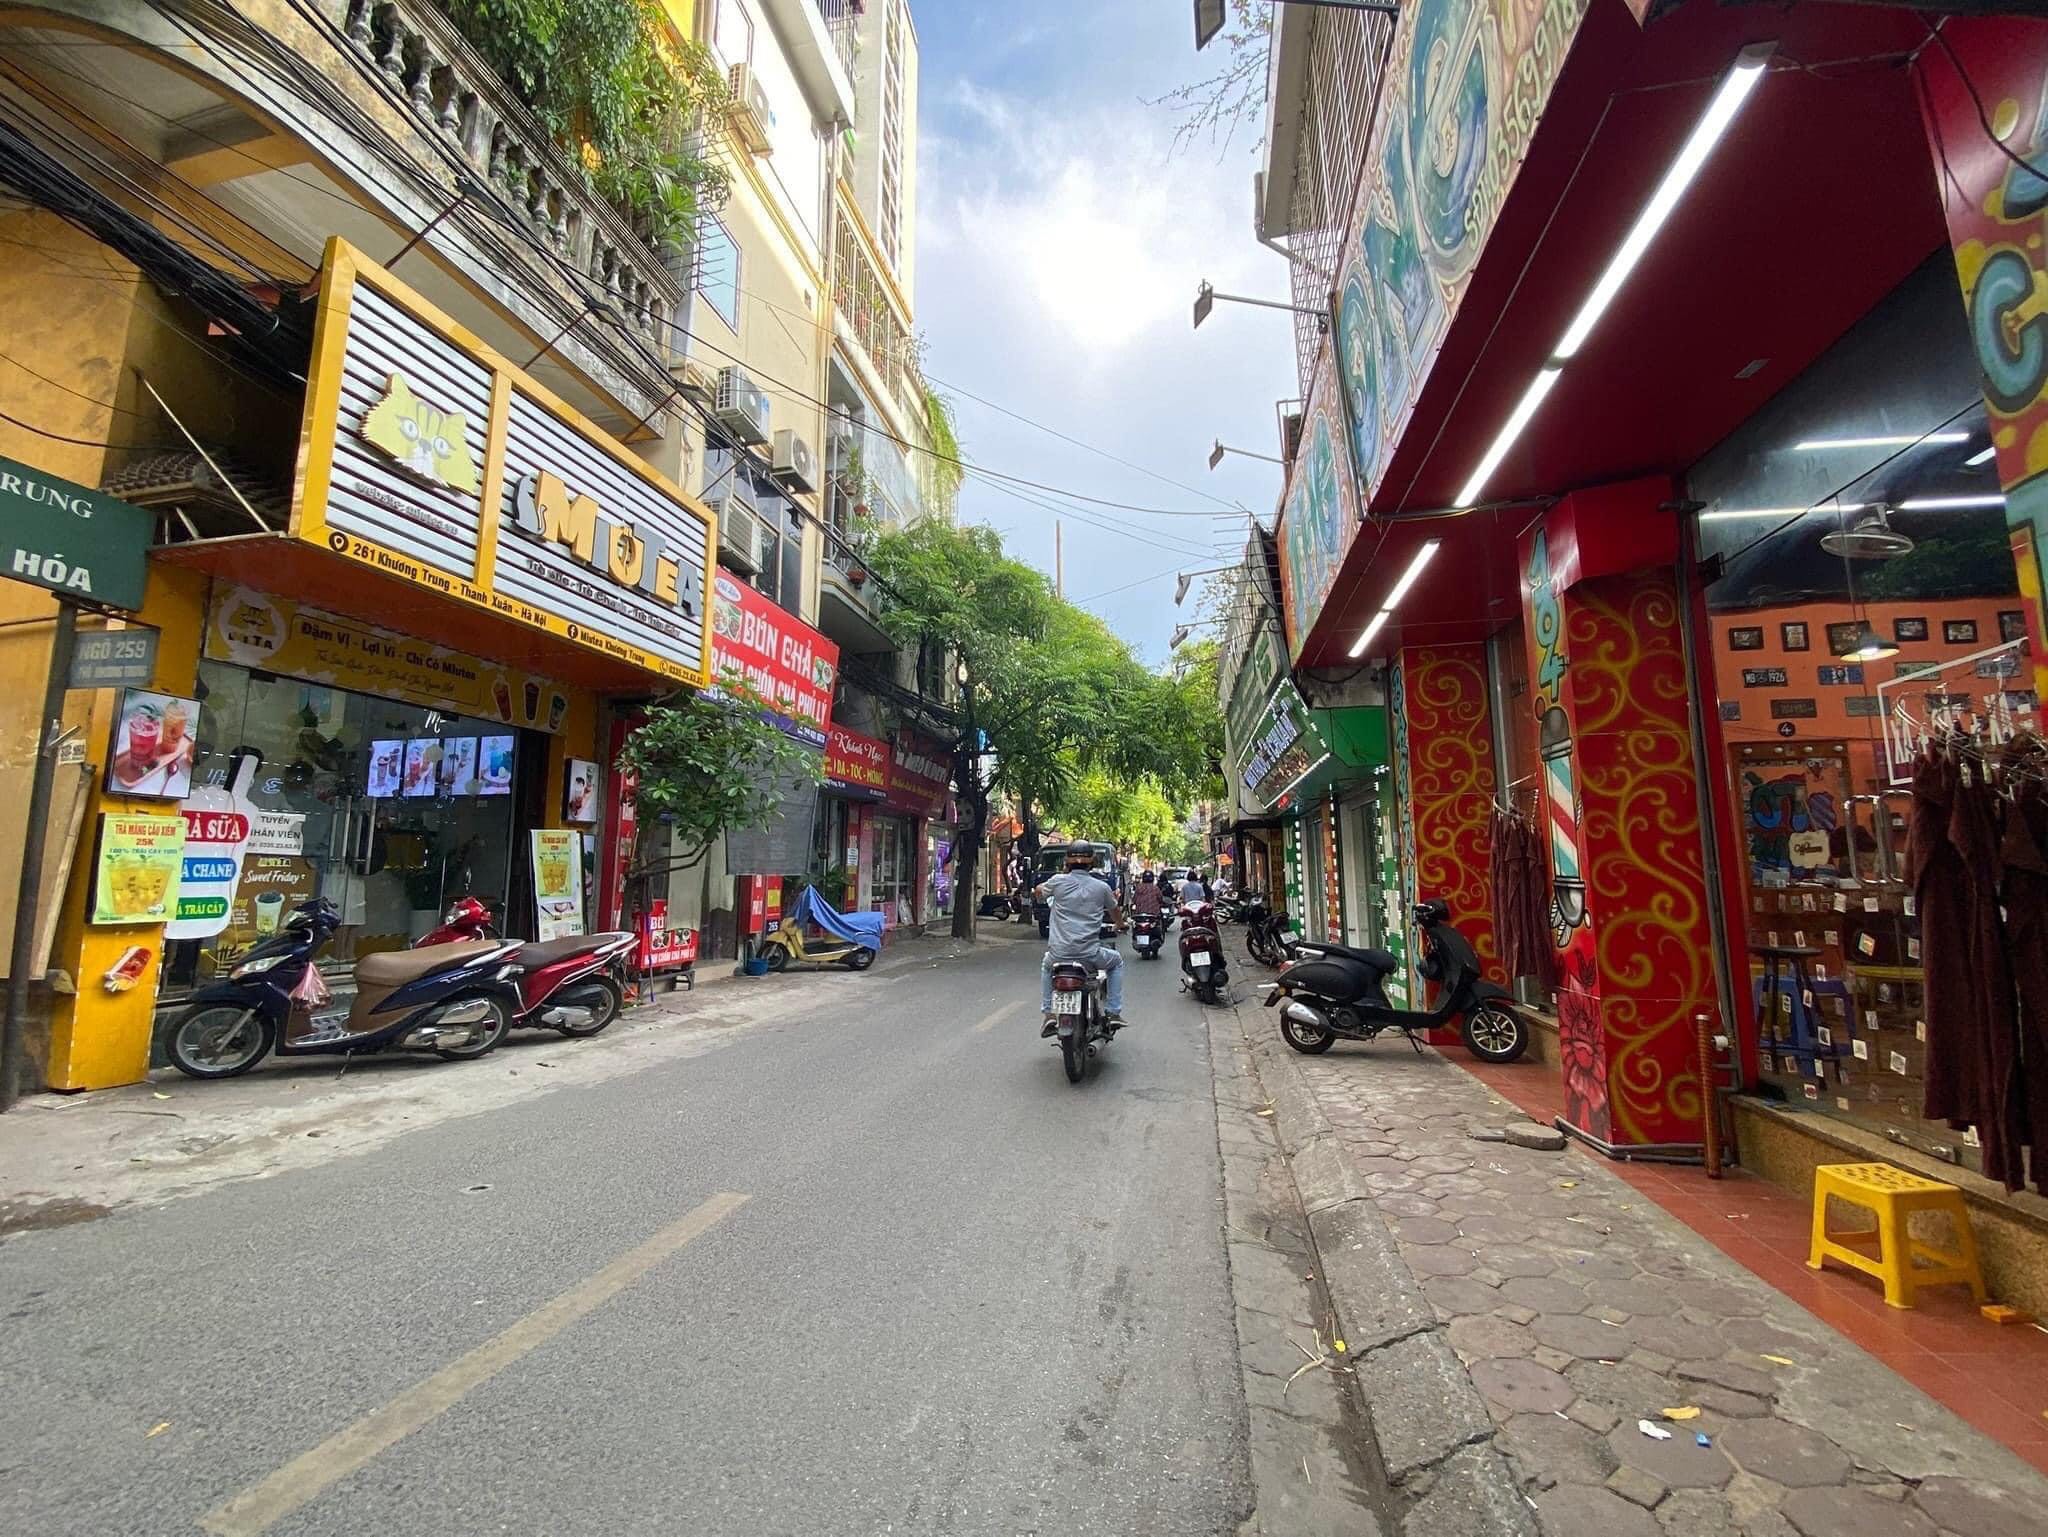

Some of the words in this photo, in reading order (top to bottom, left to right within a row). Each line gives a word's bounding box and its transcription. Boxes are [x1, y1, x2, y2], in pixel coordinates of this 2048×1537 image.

[12, 549, 92, 592] HÓA
[353, 543, 376, 562] 261
[378, 552, 418, 580] Khương
[422, 569, 450, 592] Trung
[460, 583, 488, 605] Thanh
[492, 594, 512, 613] Xuân
[521, 606, 532, 620] Hà
[533, 611, 547, 626] Nội
[115, 639, 147, 659] 259
[743, 611, 778, 660] BÚN
[781, 635, 812, 679] CHẢ
[207, 812, 241, 839] SỮA
[193, 863, 235, 878] CHANH
[185, 903, 205, 915] TRÁI
[206, 902, 225, 914] CÂY
